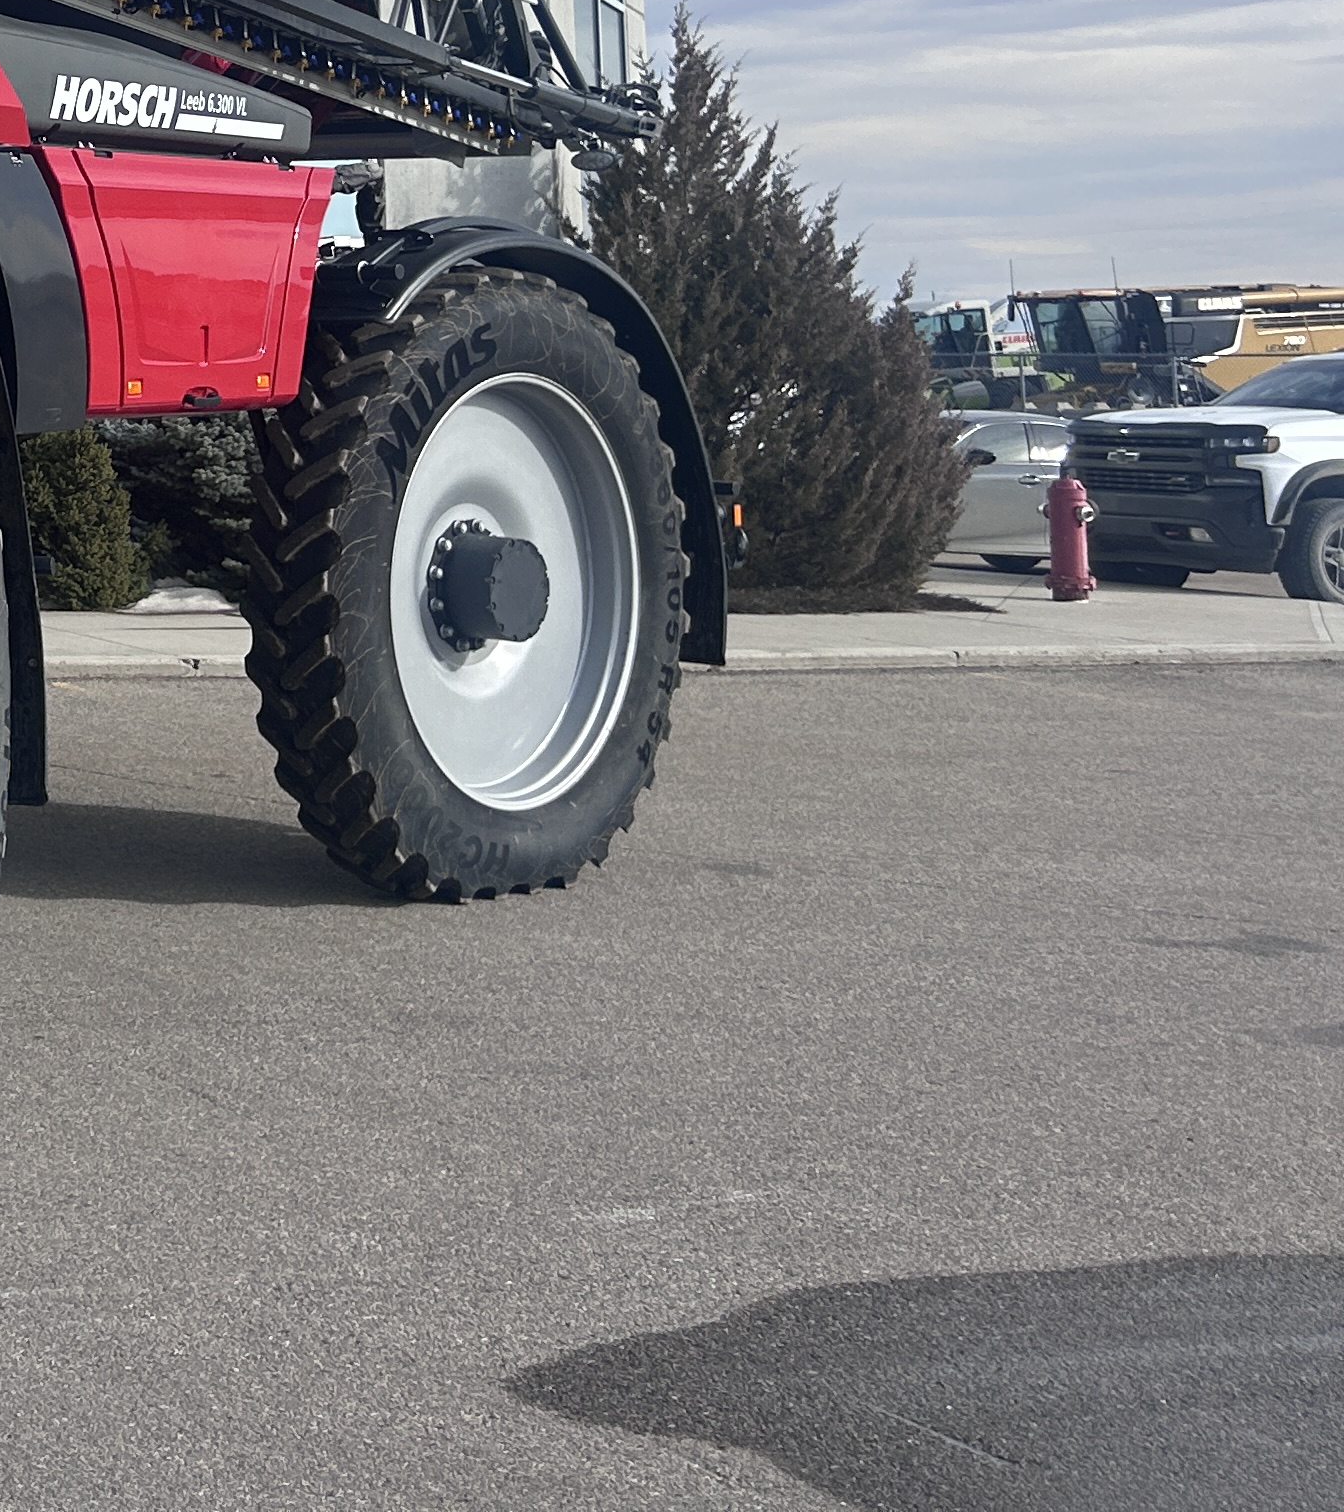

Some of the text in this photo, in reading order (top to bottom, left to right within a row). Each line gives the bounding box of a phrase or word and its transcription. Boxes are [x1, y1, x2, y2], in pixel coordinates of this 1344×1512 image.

[49, 74, 248, 129] HORSCH Leeb 6.300 VL
[376, 322, 497, 505] Mitas
